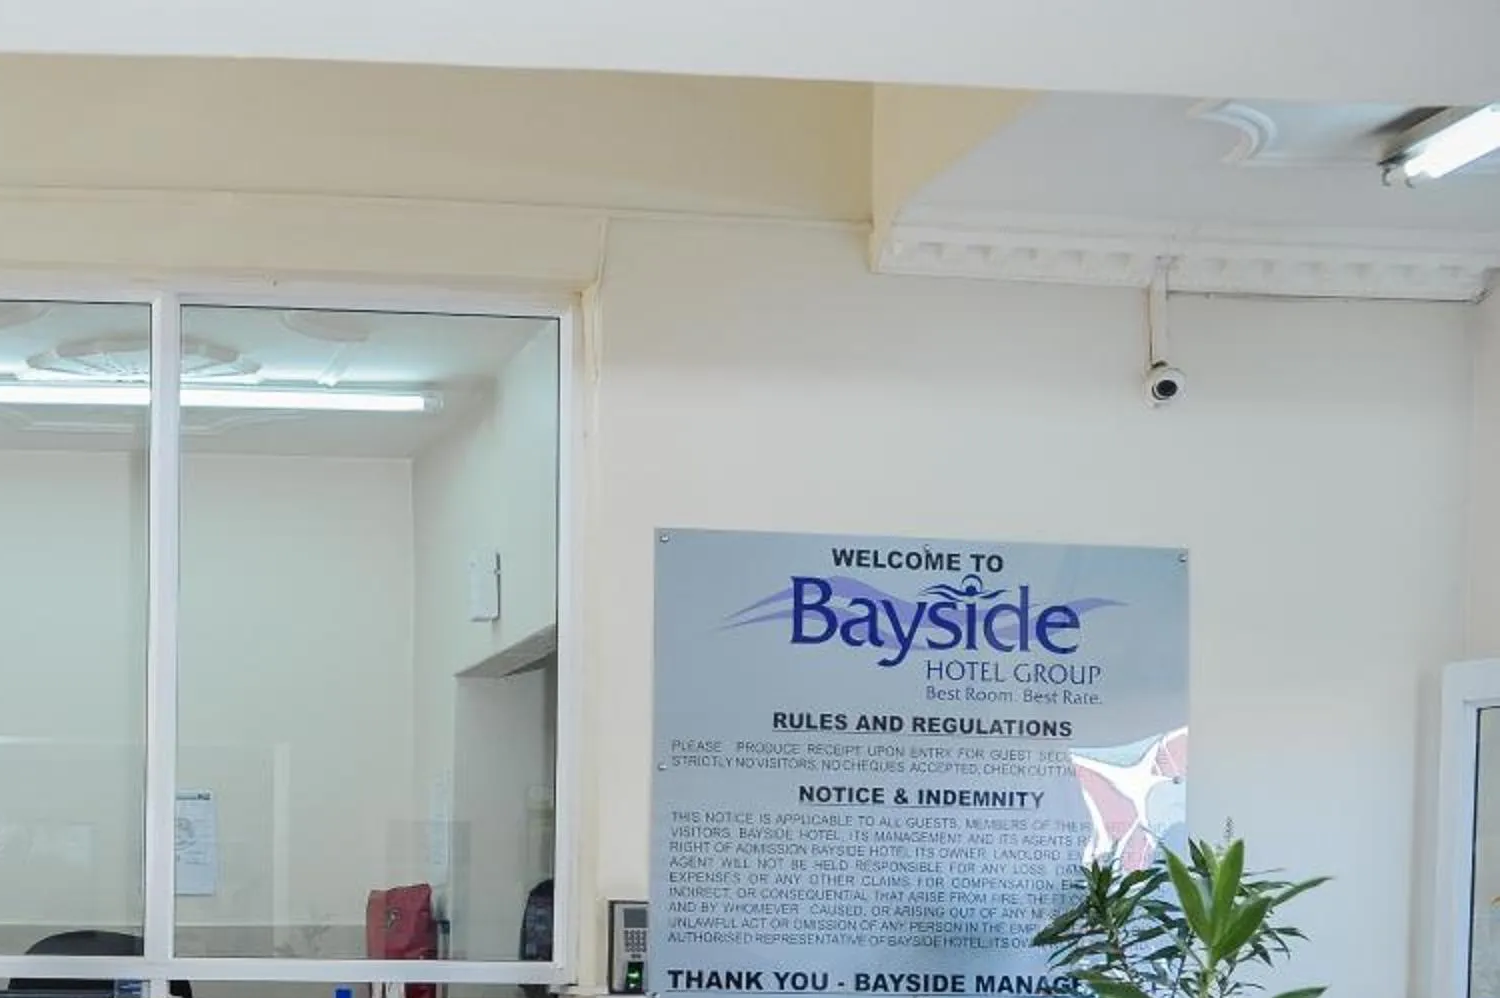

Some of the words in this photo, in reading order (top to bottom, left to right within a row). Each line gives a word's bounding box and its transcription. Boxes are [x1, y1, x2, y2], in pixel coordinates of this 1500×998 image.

[832, 547, 961, 572] WELCOME
[970, 553, 1004, 573] TO
[790, 575, 1081, 667] Bayside
[926, 660, 1005, 683] HOTEL
[1014, 663, 1102, 685] GROUP
[926, 685, 961, 701] Best
[1023, 690, 1057, 705] Best
[773, 712, 848, 731] RULES
[855, 715, 904, 732] AND
[912, 716, 1073, 737] REGULATIONS
[671, 739, 722, 753] PLEASE
[737, 741, 800, 755] PRODUCE
[807, 743, 862, 757] RECEIPT
[867, 746, 904, 758] UPON
[910, 747, 951, 759] ENTRY
[957, 748, 985, 760] FOR
[990, 749, 1032, 762] GUEST
[671, 755, 733, 768] STRICTLY
[734, 756, 753, 769] NO
[821, 759, 841, 771] NO
[842, 760, 905, 773] CHEQUES
[983, 763, 1025, 776] CHECK
[799, 785, 885, 804] NOTICE
[893, 788, 909, 805] &
[918, 789, 1045, 809] INDEMNITY
[671, 811, 700, 823] THIS
[705, 812, 752, 824] NOTICE
[760, 813, 771, 825] IS
[775, 813, 853, 826] APPLICABLE
[858, 815, 875, 827] TO
[879, 816, 901, 828] ALL
[965, 818, 1027, 831] MEMBERS
[1032, 819, 1053, 831] OF
[739, 827, 794, 841] BAYSIDE
[849, 830, 869, 841] ITS
[875, 831, 962, 845] MANAGEMENT
[969, 833, 994, 845] AND
[999, 834, 1018, 845] ITS
[1023, 835, 1071, 847] AGENTS
[669, 841, 711, 853] RIGHT
[713, 842, 733, 853] OF
[736, 843, 807, 855] ADMISSION
[811, 844, 865, 857] BAYSIDE
[915, 847, 934, 858] ITS
[669, 856, 715, 869] AGENT
[721, 857, 749, 869] WILL
[757, 858, 784, 870] NOT
[791, 859, 807, 870] BE
[813, 859, 849, 871] HELD
[855, 860, 942, 873] RESPONSIBLE
[950, 862, 976, 873] FOR
[981, 862, 1007, 874] ANY
[669, 871, 741, 884] EXPENSES
[748, 873, 769, 884] OR
[775, 873, 801, 885] ANY
[809, 874, 855, 887] OTHER
[861, 876, 911, 888] CLAIMS
[918, 877, 945, 888] FOR
[952, 877, 1053, 890] COMPENSATION
[736, 888, 756, 899] OR
[874, 891, 904, 902] THAT
[908, 891, 946, 903] ARISE
[950, 892, 987, 904] FROM
[668, 901, 697, 913] AND
[701, 902, 718, 913] BY
[723, 903, 799, 915] WHOMEVER
[871, 906, 891, 917] OR
[894, 906, 946, 918] ARISING
[950, 907, 975, 919] OUT
[979, 908, 997, 919] OF
[1002, 908, 1027, 919] ANY
[668, 916, 737, 929] UNLAWFUL
[742, 918, 767, 929] ACT
[770, 918, 789, 930] OR
[794, 919, 857, 931] OMISSION
[860, 920, 878, 931] OF
[881, 921, 905, 932] ANY
[909, 921, 963, 933] PERSON
[965, 922, 978, 933] IN
[982, 922, 1005, 934] THE
[668, 932, 754, 945] AUTHORISED
[755, 933, 867, 947] REPRESENTATIVE
[868, 935, 886, 947] OF
[888, 936, 942, 948] BAYSIDE
[990, 937, 1009, 949] ITS
[667, 969, 764, 990] THANK
[773, 971, 829, 991] YOU
[855, 972, 966, 993] BAYSIDE
